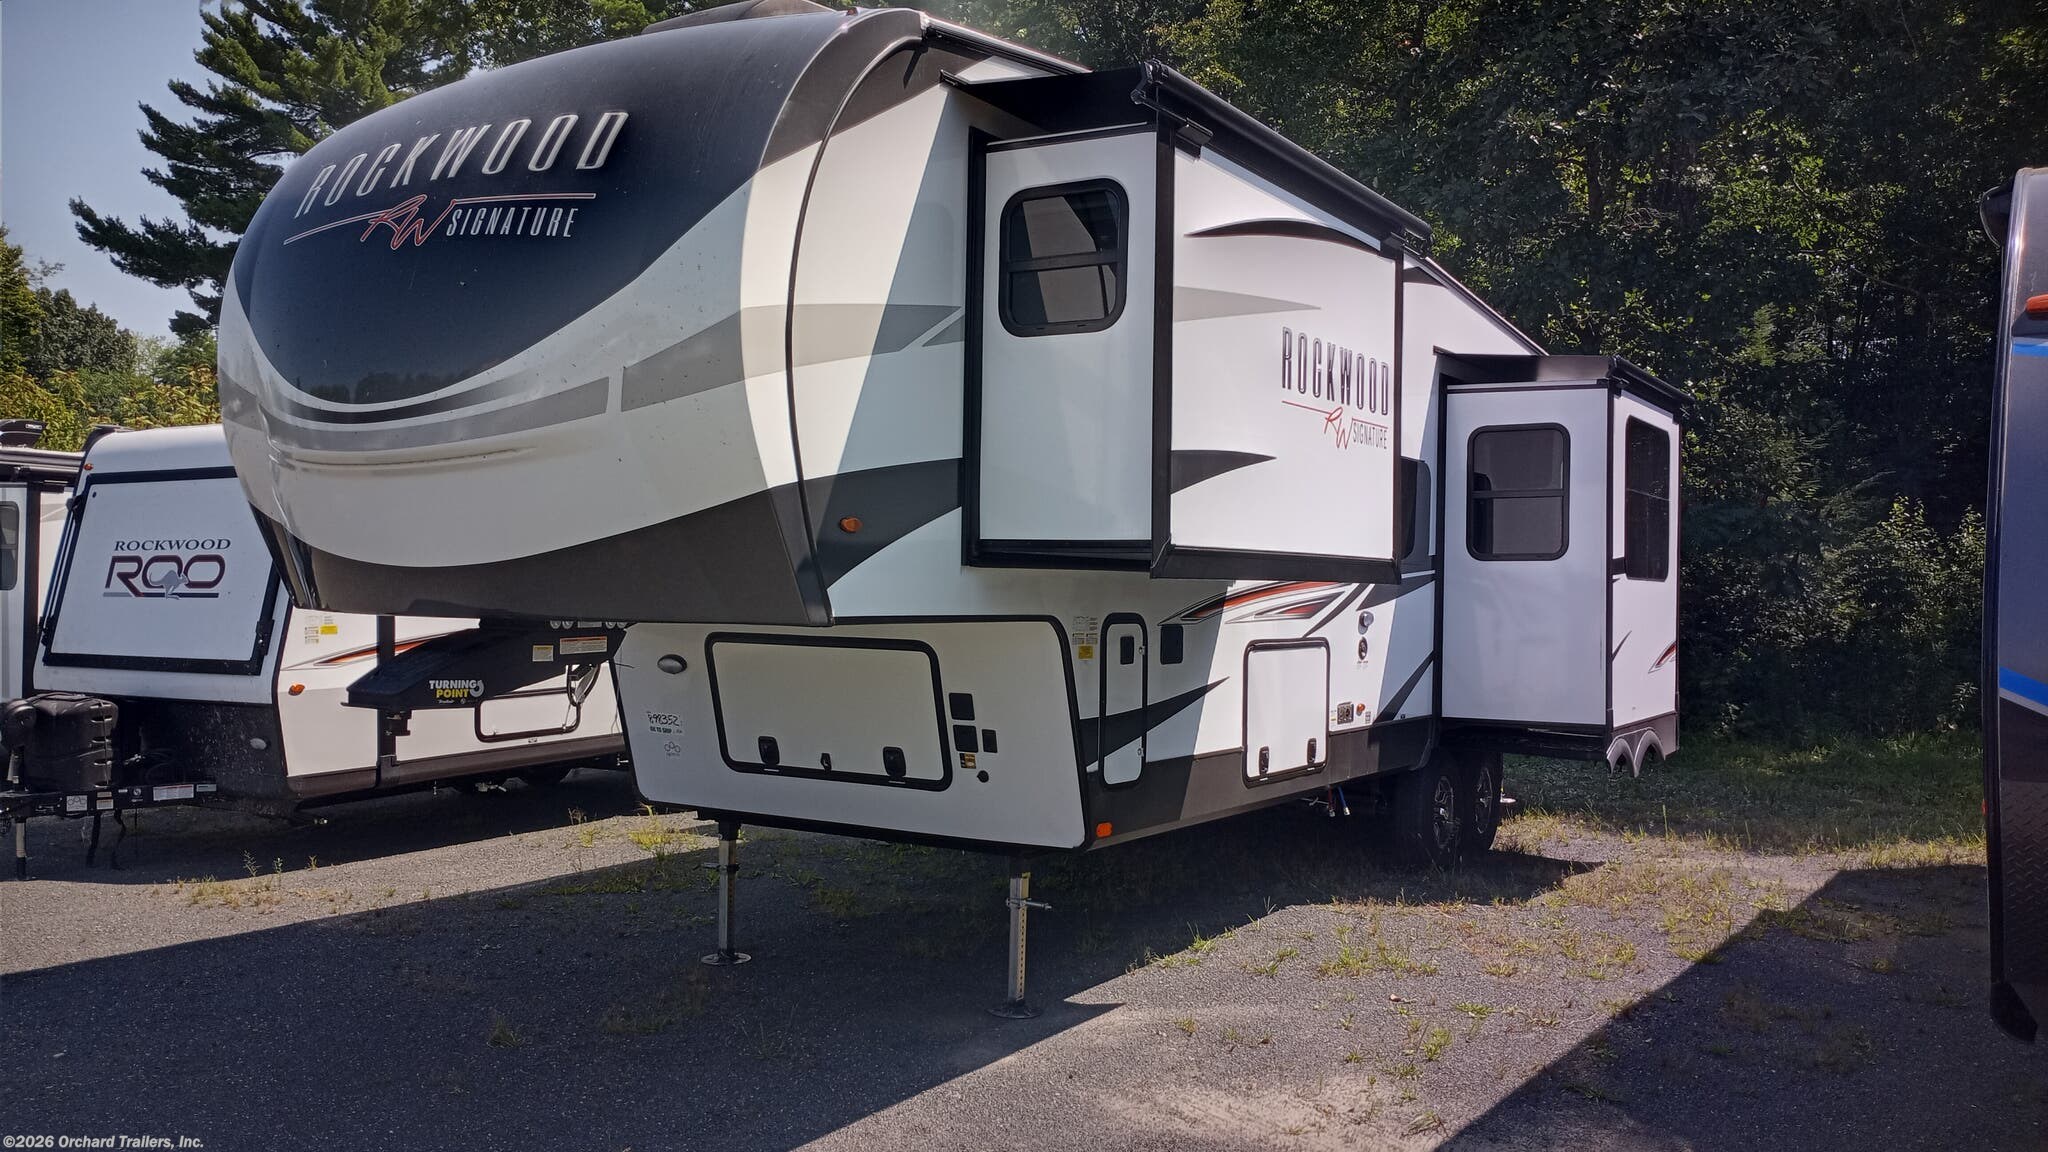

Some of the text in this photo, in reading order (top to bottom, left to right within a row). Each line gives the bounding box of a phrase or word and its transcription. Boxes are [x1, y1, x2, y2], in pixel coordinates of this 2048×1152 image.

[294, 111, 629, 219] ROCKWOOD
[446, 207, 579, 239] SIGNATURE
[1281, 326, 1389, 416] ROCKWOOD
[1352, 422, 1388, 449] SIGNATURE
[114, 538, 231, 551] ROCKWOOD
[104, 554, 226, 598] ROO
[429, 679, 477, 689] TURNING
[436, 689, 469, 698] POINT
